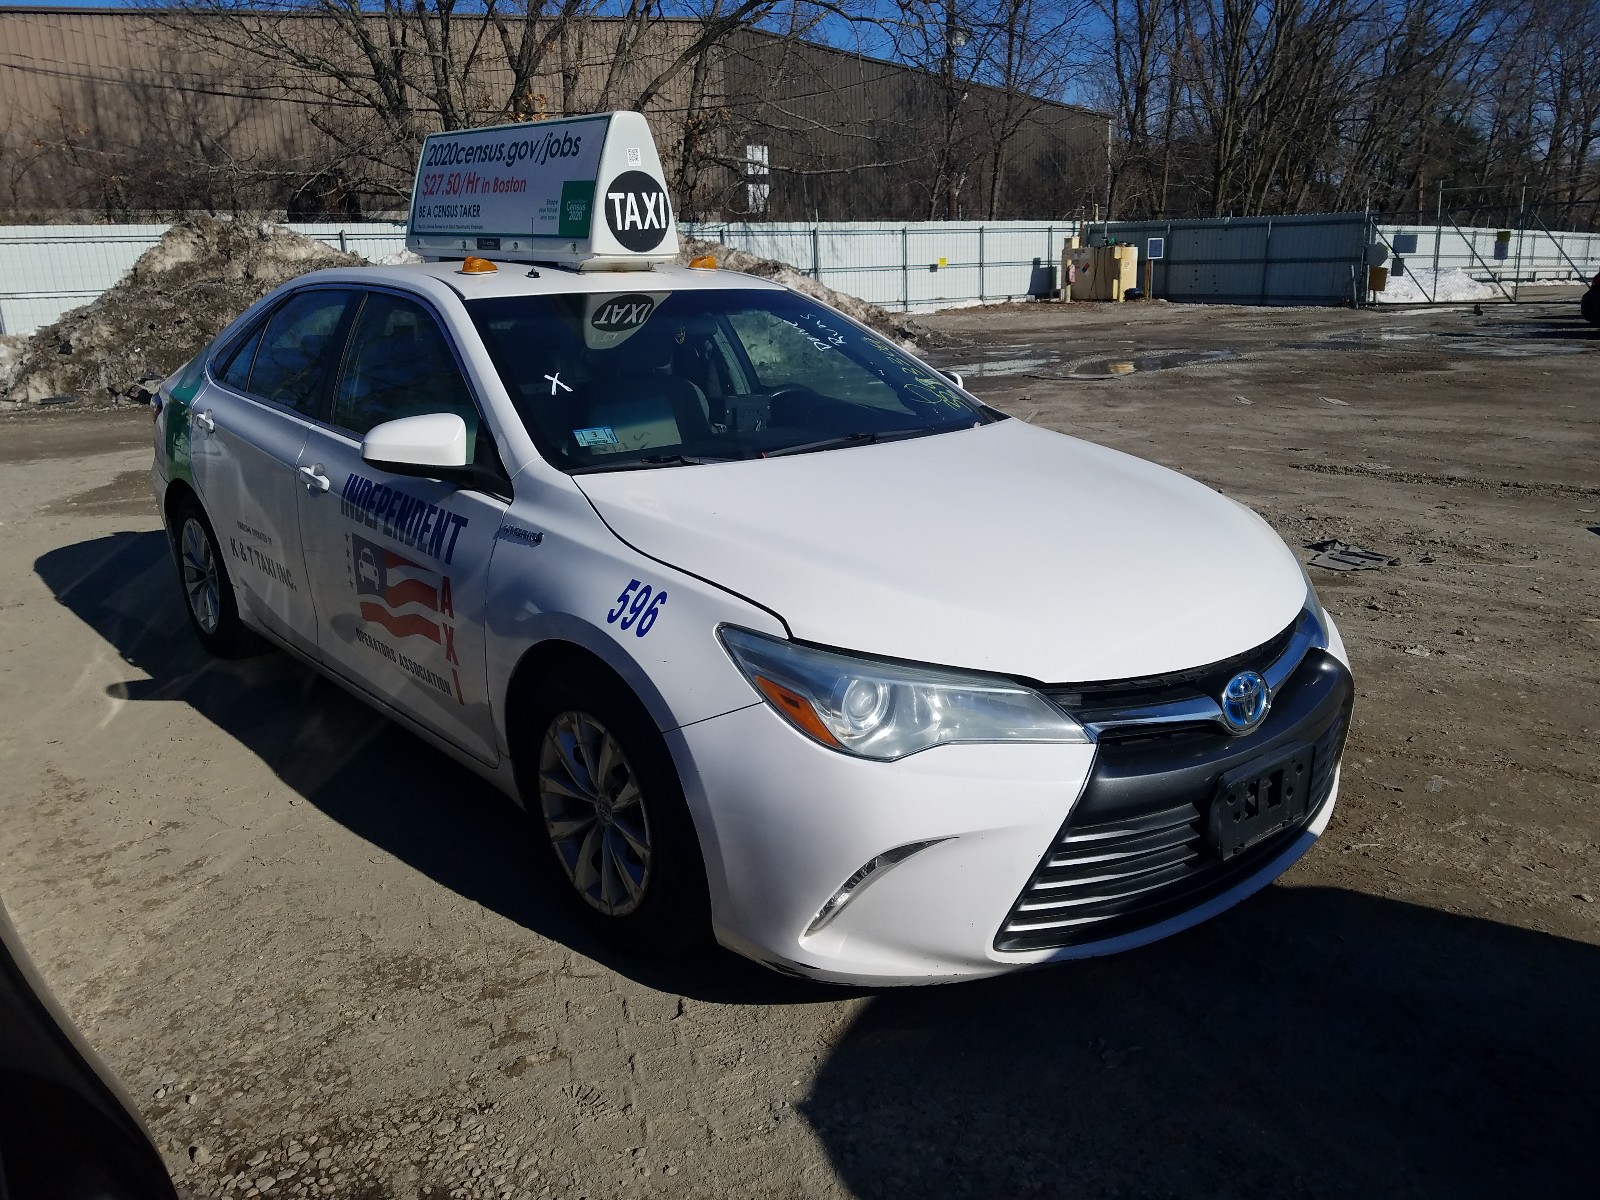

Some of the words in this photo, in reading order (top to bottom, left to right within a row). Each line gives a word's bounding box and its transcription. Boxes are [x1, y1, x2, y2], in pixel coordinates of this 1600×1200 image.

[426, 131, 582, 167] 2020census.gov/jobs
[422, 171, 481, 199] $27.50/Hr
[481, 177, 490, 194] in
[492, 175, 527, 193] Boston
[418, 205, 426, 218] BE
[426, 205, 432, 218] A
[432, 204, 458, 218] CENSUS
[459, 204, 481, 218] TAKER
[566, 200, 586, 211] Census
[568, 210, 583, 221] 2020
[608, 192, 666, 231] TAXI
[340, 472, 469, 565] INDEPENDENT
[254, 549, 277, 580] TAXI
[606, 578, 668, 638] 596
[355, 627, 398, 664] OPERATORS
[398, 653, 453, 697] ASSOCIATION
